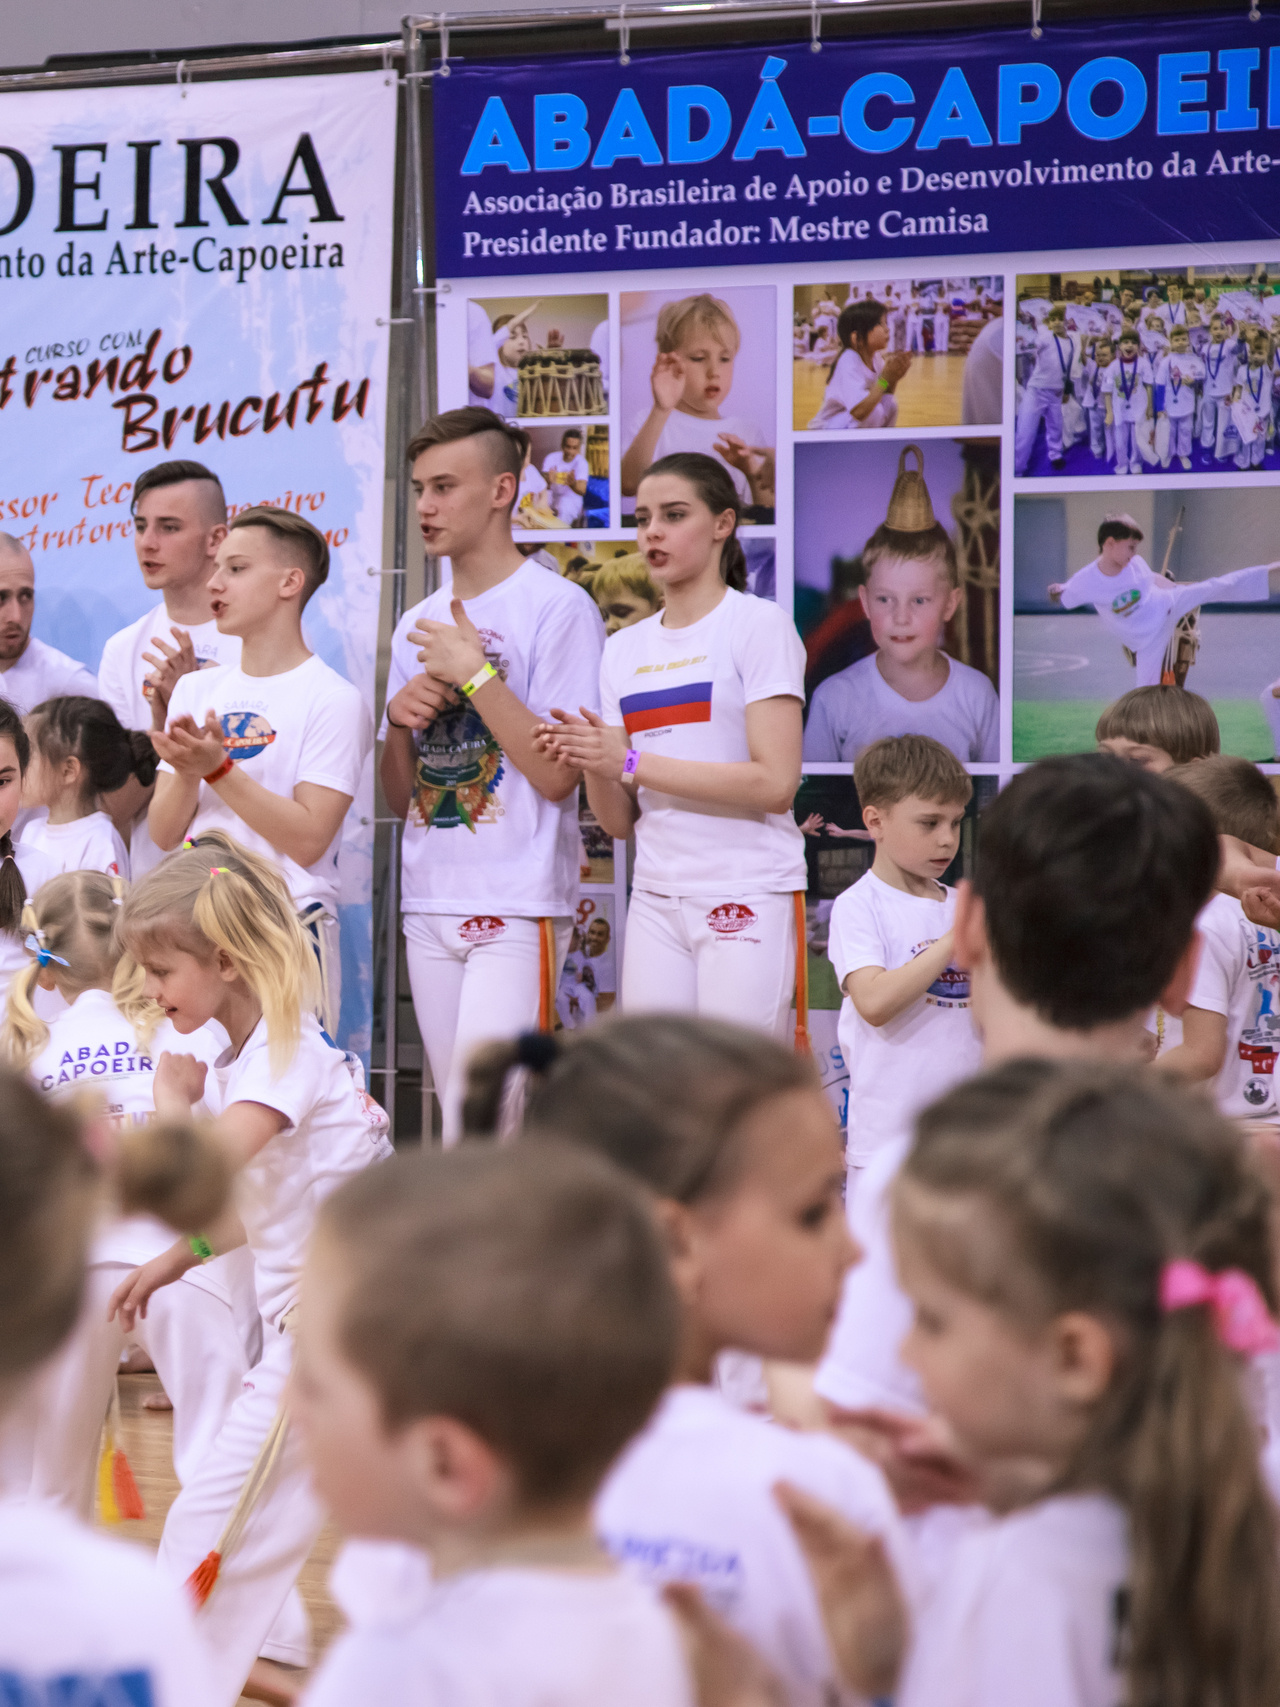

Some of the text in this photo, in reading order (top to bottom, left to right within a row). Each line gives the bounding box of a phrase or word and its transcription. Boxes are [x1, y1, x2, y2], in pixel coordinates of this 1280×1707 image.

[460, 45, 1280, 176] ABADÁ-CAPOEI
[462, 186, 603, 217] Associação
[610, 178, 737, 208] Brasileira
[744, 175, 777, 201] de
[785, 171, 870, 206] Apoio
[877, 176, 893, 195] e
[900, 156, 1154, 194] Desenvolvimento
[1162, 151, 1198, 179] da
[462, 207, 990, 258] Presidente Fundador: Mestre Camisa
[57, 240, 95, 277] da
[106, 233, 345, 286] Arte-Capoeira
[24, 328, 143, 366] CURSO COM
[110, 361, 370, 454] Brucutu
[19, 516, 134, 551] trutore
[40, 1055, 157, 1092] CAPOEIR
